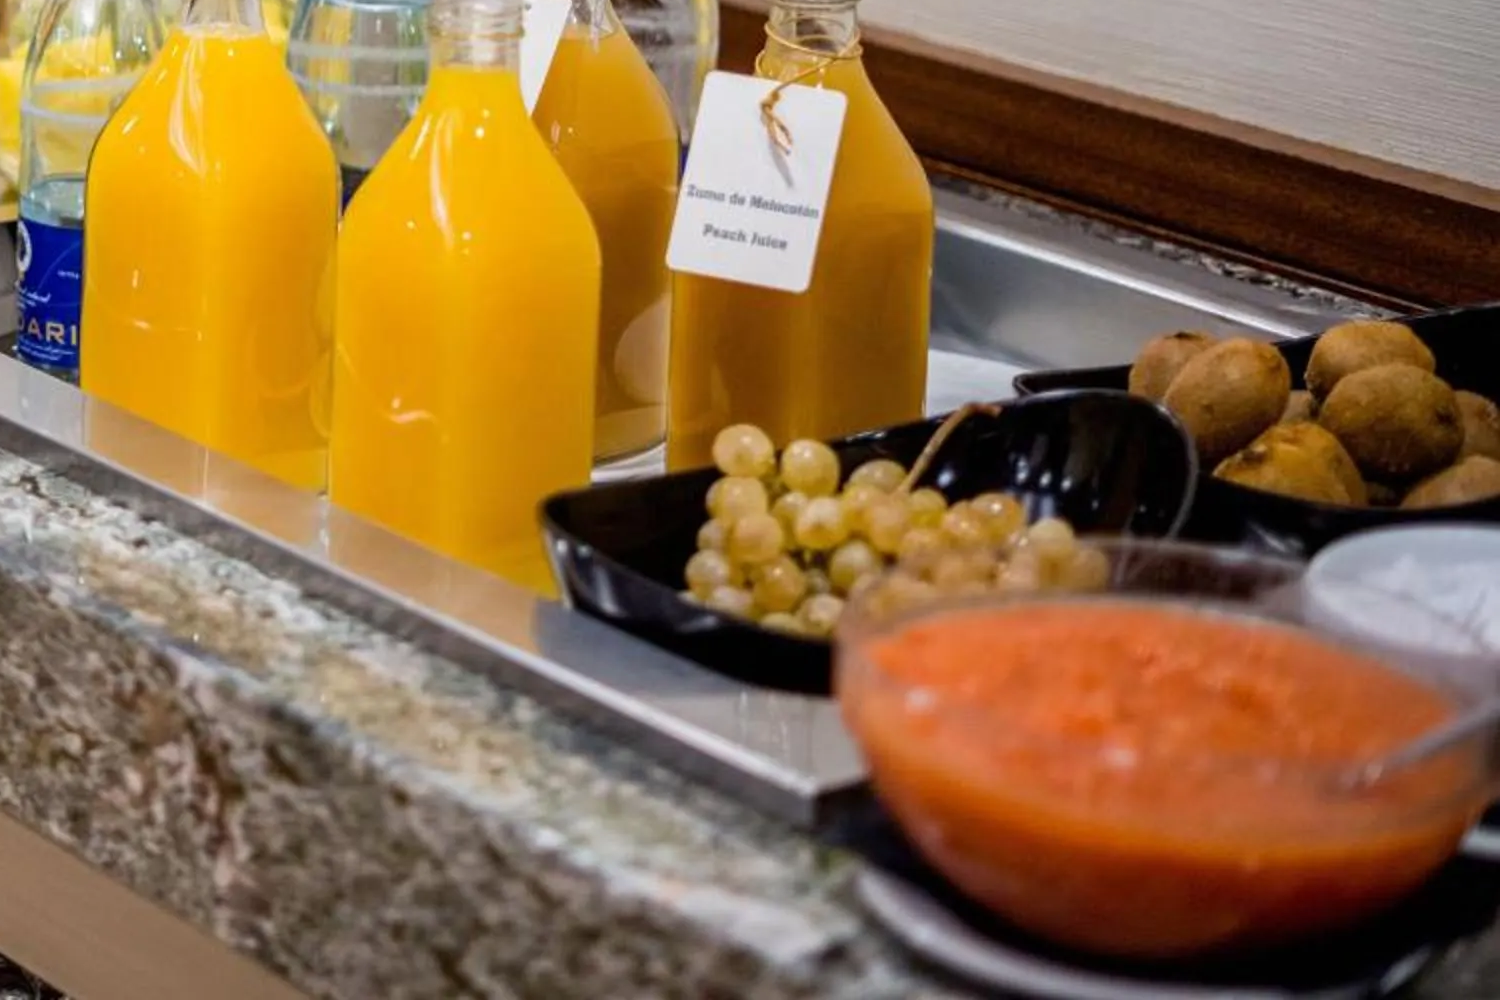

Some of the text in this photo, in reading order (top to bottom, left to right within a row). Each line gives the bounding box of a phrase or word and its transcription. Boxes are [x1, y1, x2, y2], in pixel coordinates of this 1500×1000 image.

[730, 193, 746, 205] de
[702, 223, 788, 251] Peach Juice
